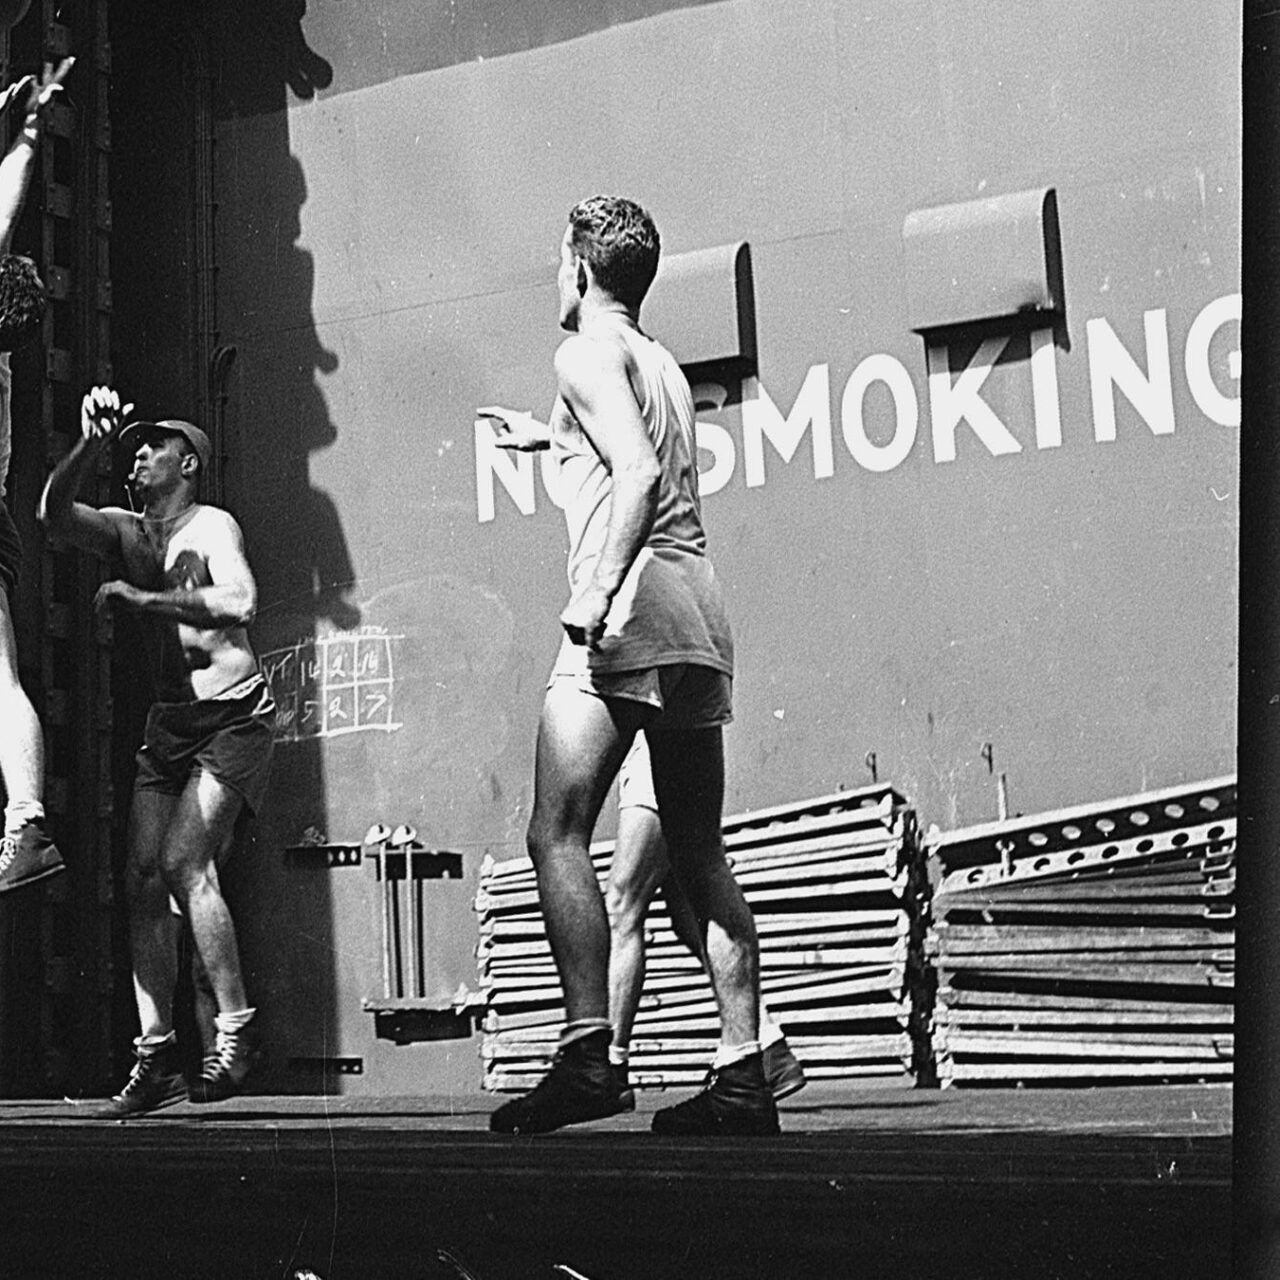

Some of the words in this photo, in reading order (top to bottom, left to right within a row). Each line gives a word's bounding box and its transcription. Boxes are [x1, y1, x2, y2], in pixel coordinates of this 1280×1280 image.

[474, 409, 568, 523] N
[693, 293, 1242, 498] SMOKING
[365, 693, 387, 719] 7
